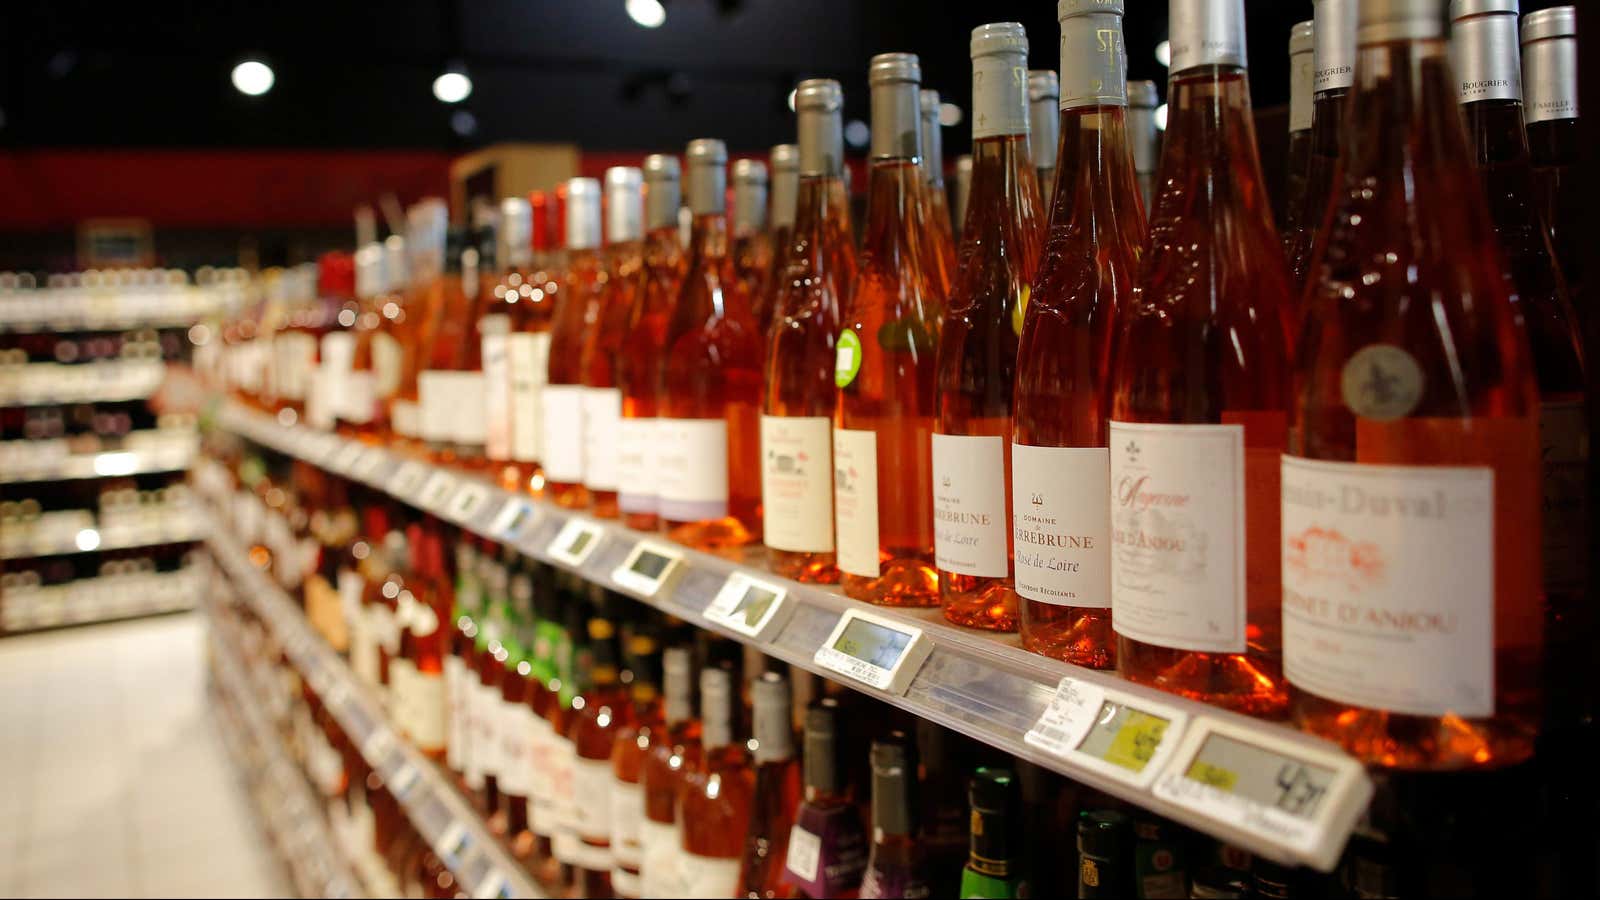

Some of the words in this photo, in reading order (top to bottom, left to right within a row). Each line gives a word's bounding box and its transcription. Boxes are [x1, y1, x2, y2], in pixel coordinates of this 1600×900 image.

[1463, 79, 1508, 91] BOUGRIER
[1023, 514, 1057, 525] DOMAINE
[1015, 526, 1094, 549] ERREBRUNE
[1033, 552, 1044, 569] de
[1046, 556, 1080, 573] Loire
